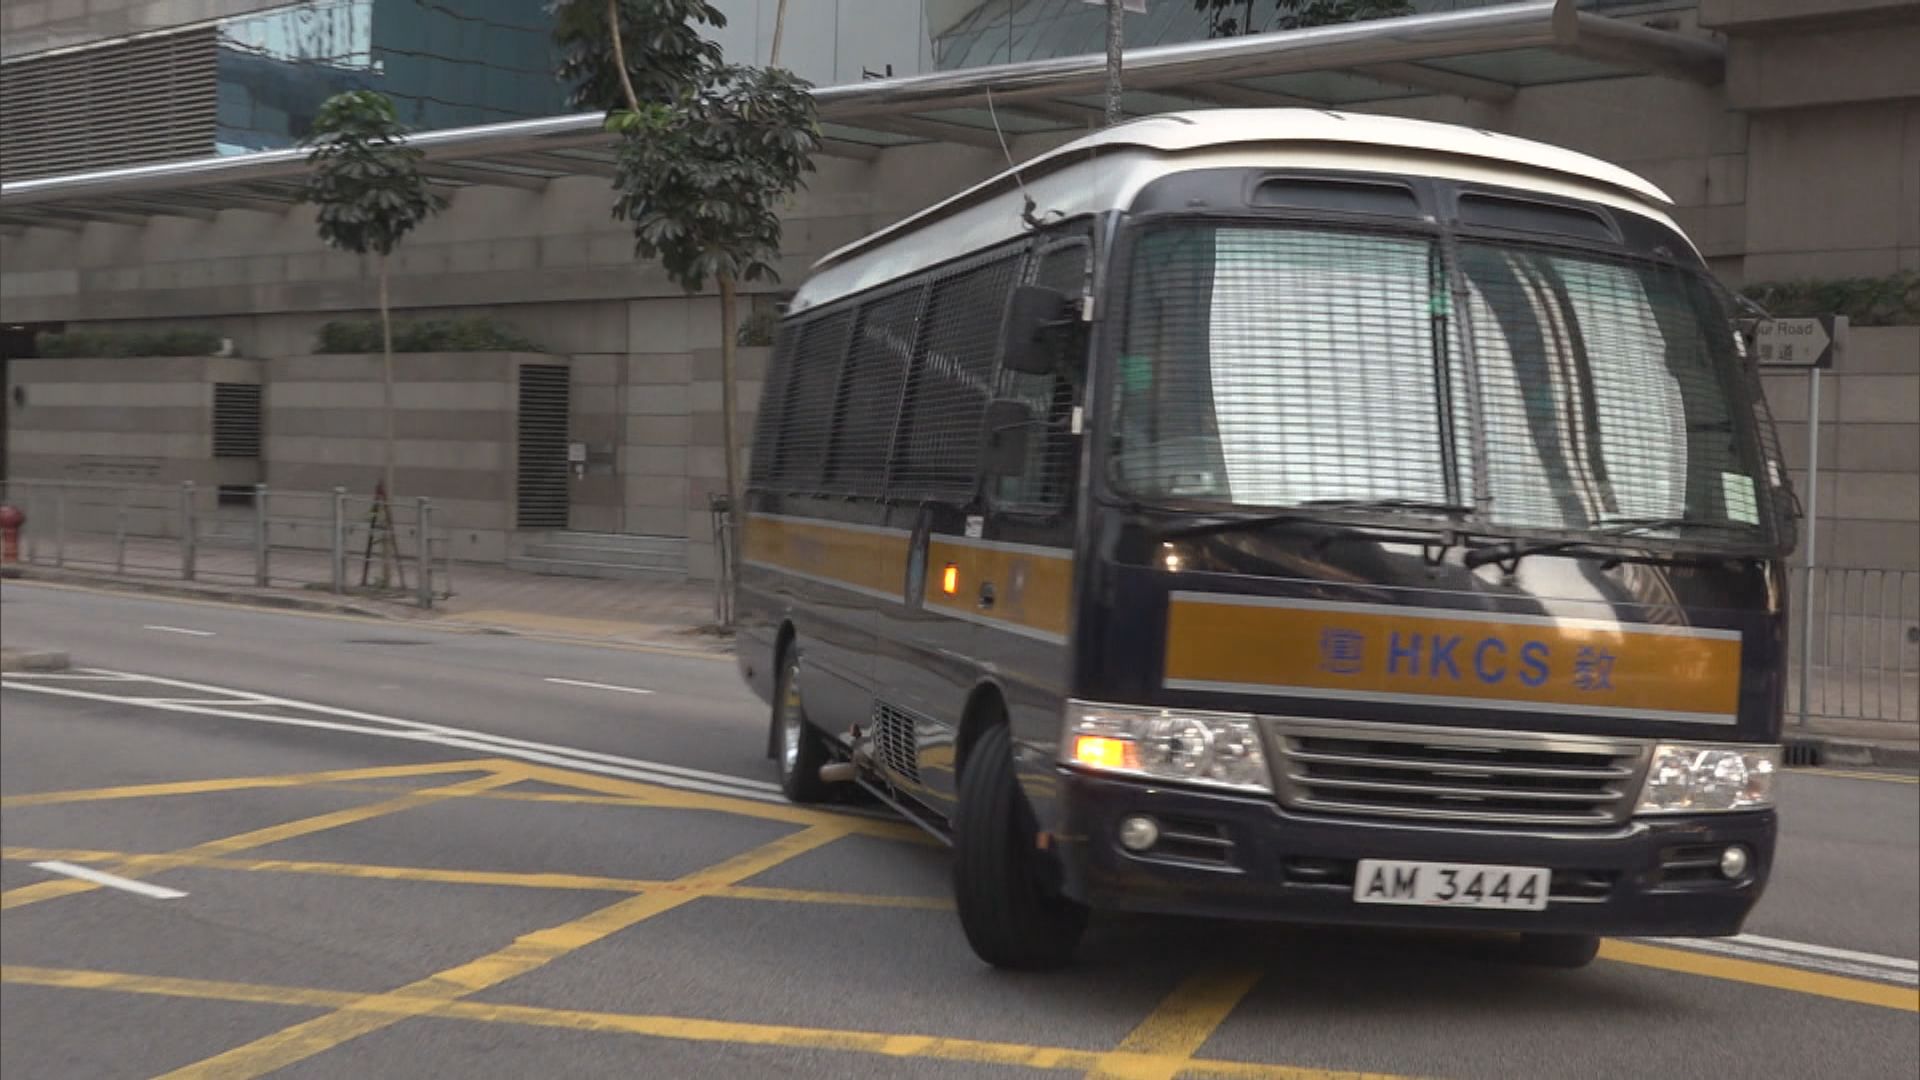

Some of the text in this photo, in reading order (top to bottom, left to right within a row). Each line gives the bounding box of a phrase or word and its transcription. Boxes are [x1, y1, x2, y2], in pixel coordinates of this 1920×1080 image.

[1777, 321, 1813, 335] Road
[1387, 631, 1551, 688] HKCS
[1366, 866, 1539, 905] AM 3444
